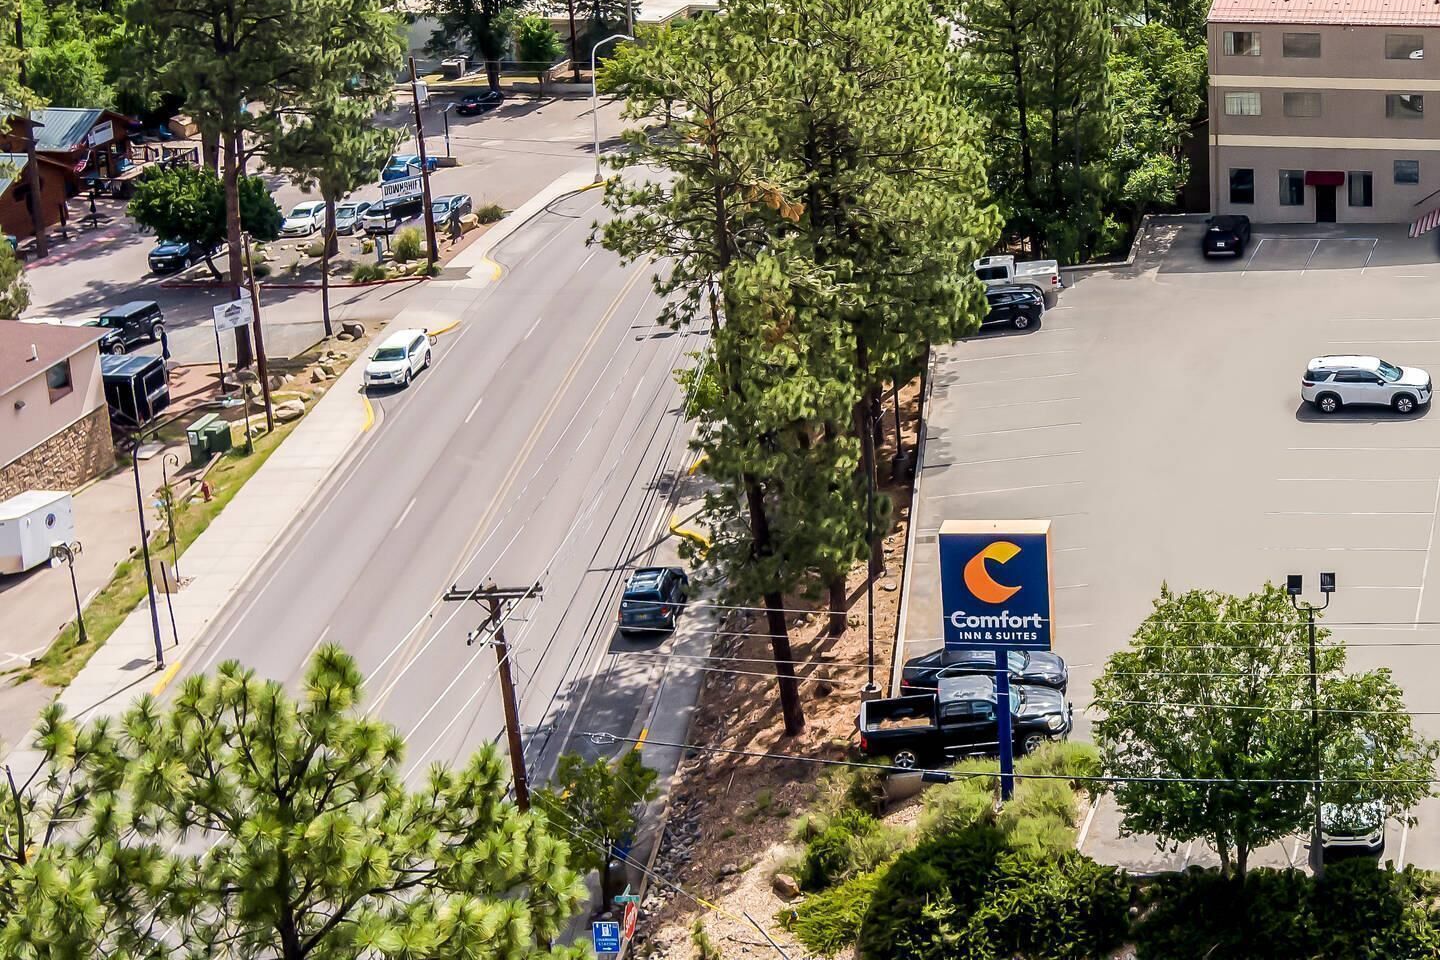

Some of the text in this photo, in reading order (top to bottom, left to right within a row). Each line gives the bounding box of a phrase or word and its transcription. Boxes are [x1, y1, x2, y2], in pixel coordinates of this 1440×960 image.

[384, 180, 419, 196] DOWNSHIF
[951, 610, 1042, 628] Comfort
[985, 631, 993, 640] &
[996, 632, 1037, 640] SUITES
